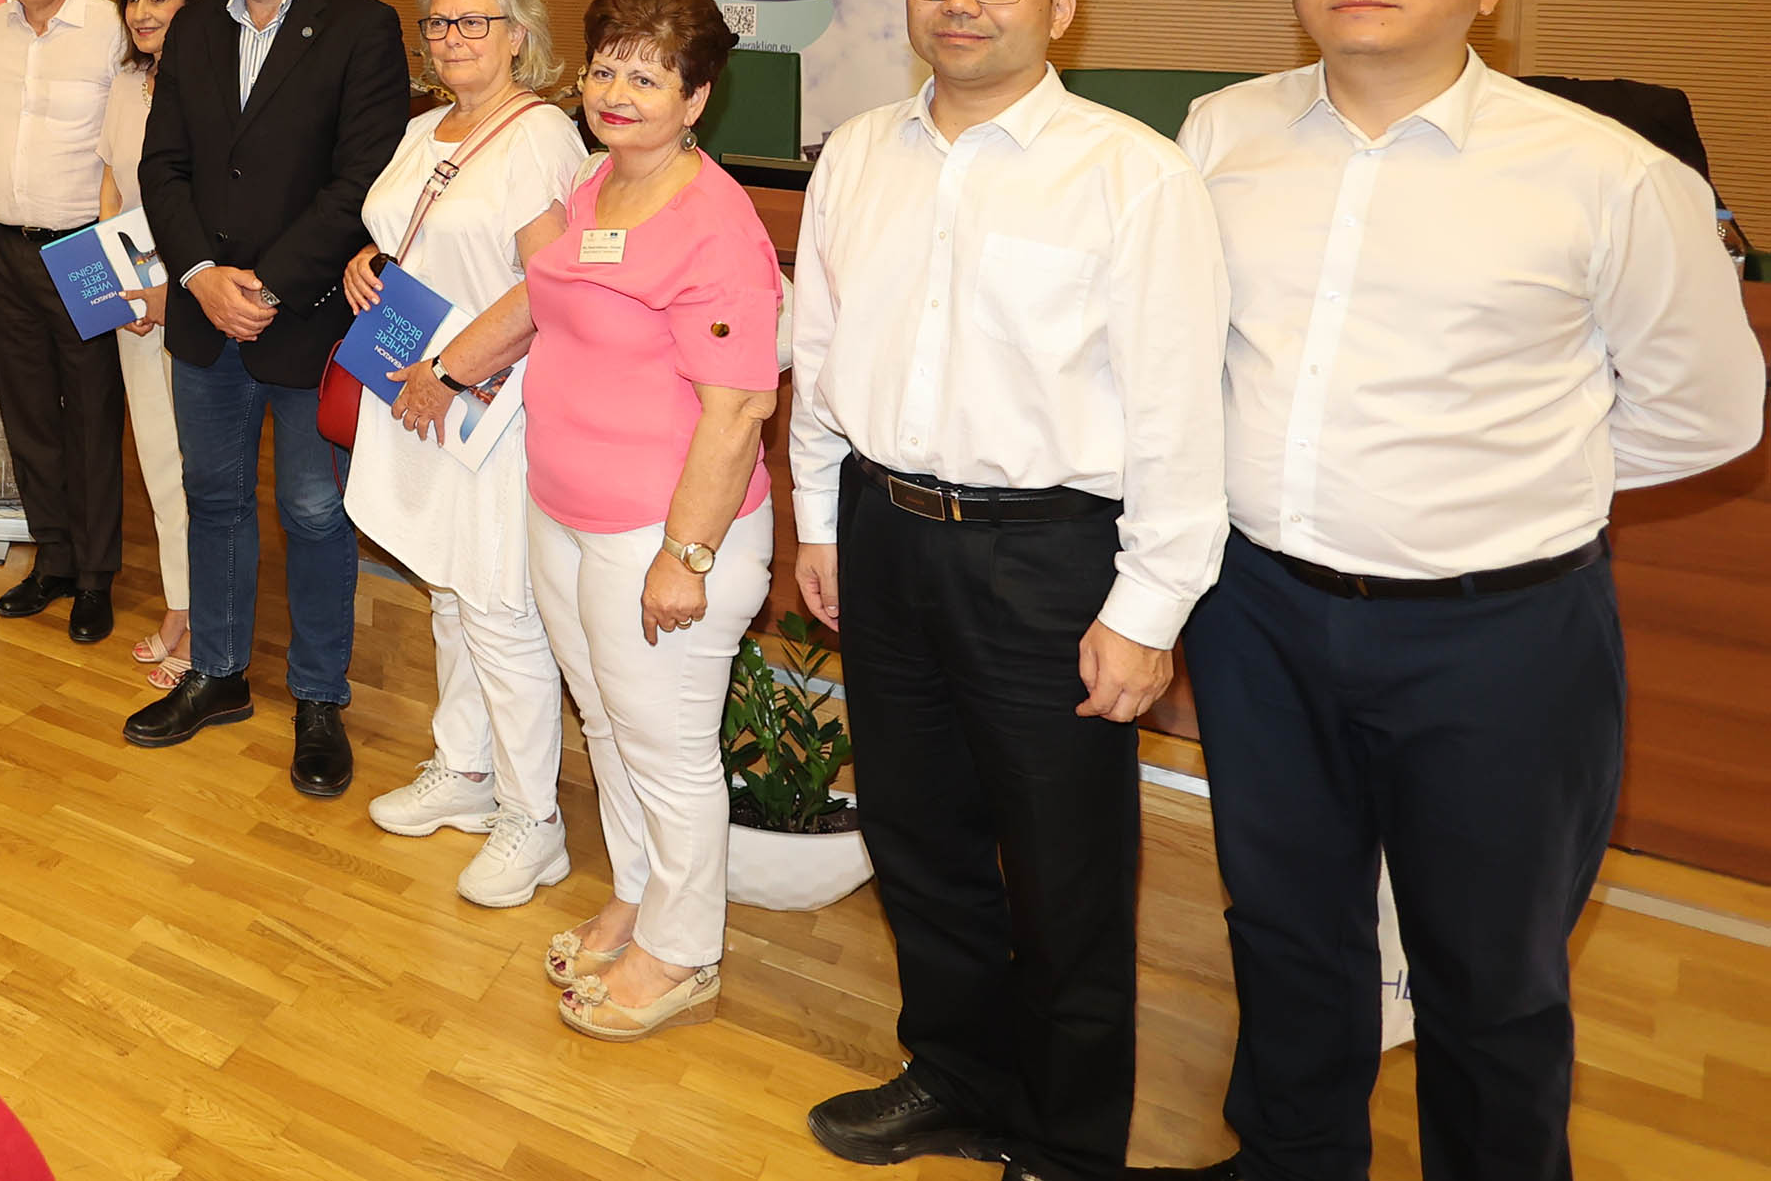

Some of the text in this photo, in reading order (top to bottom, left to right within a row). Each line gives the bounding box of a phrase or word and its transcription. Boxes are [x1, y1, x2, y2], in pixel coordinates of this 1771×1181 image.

[80, 281, 113, 299] WHERE
[81, 271, 108, 288] CRETE
[382, 305, 423, 341] BEGINS!
[386, 323, 417, 350] CRETE
[374, 329, 410, 362] WHERE
